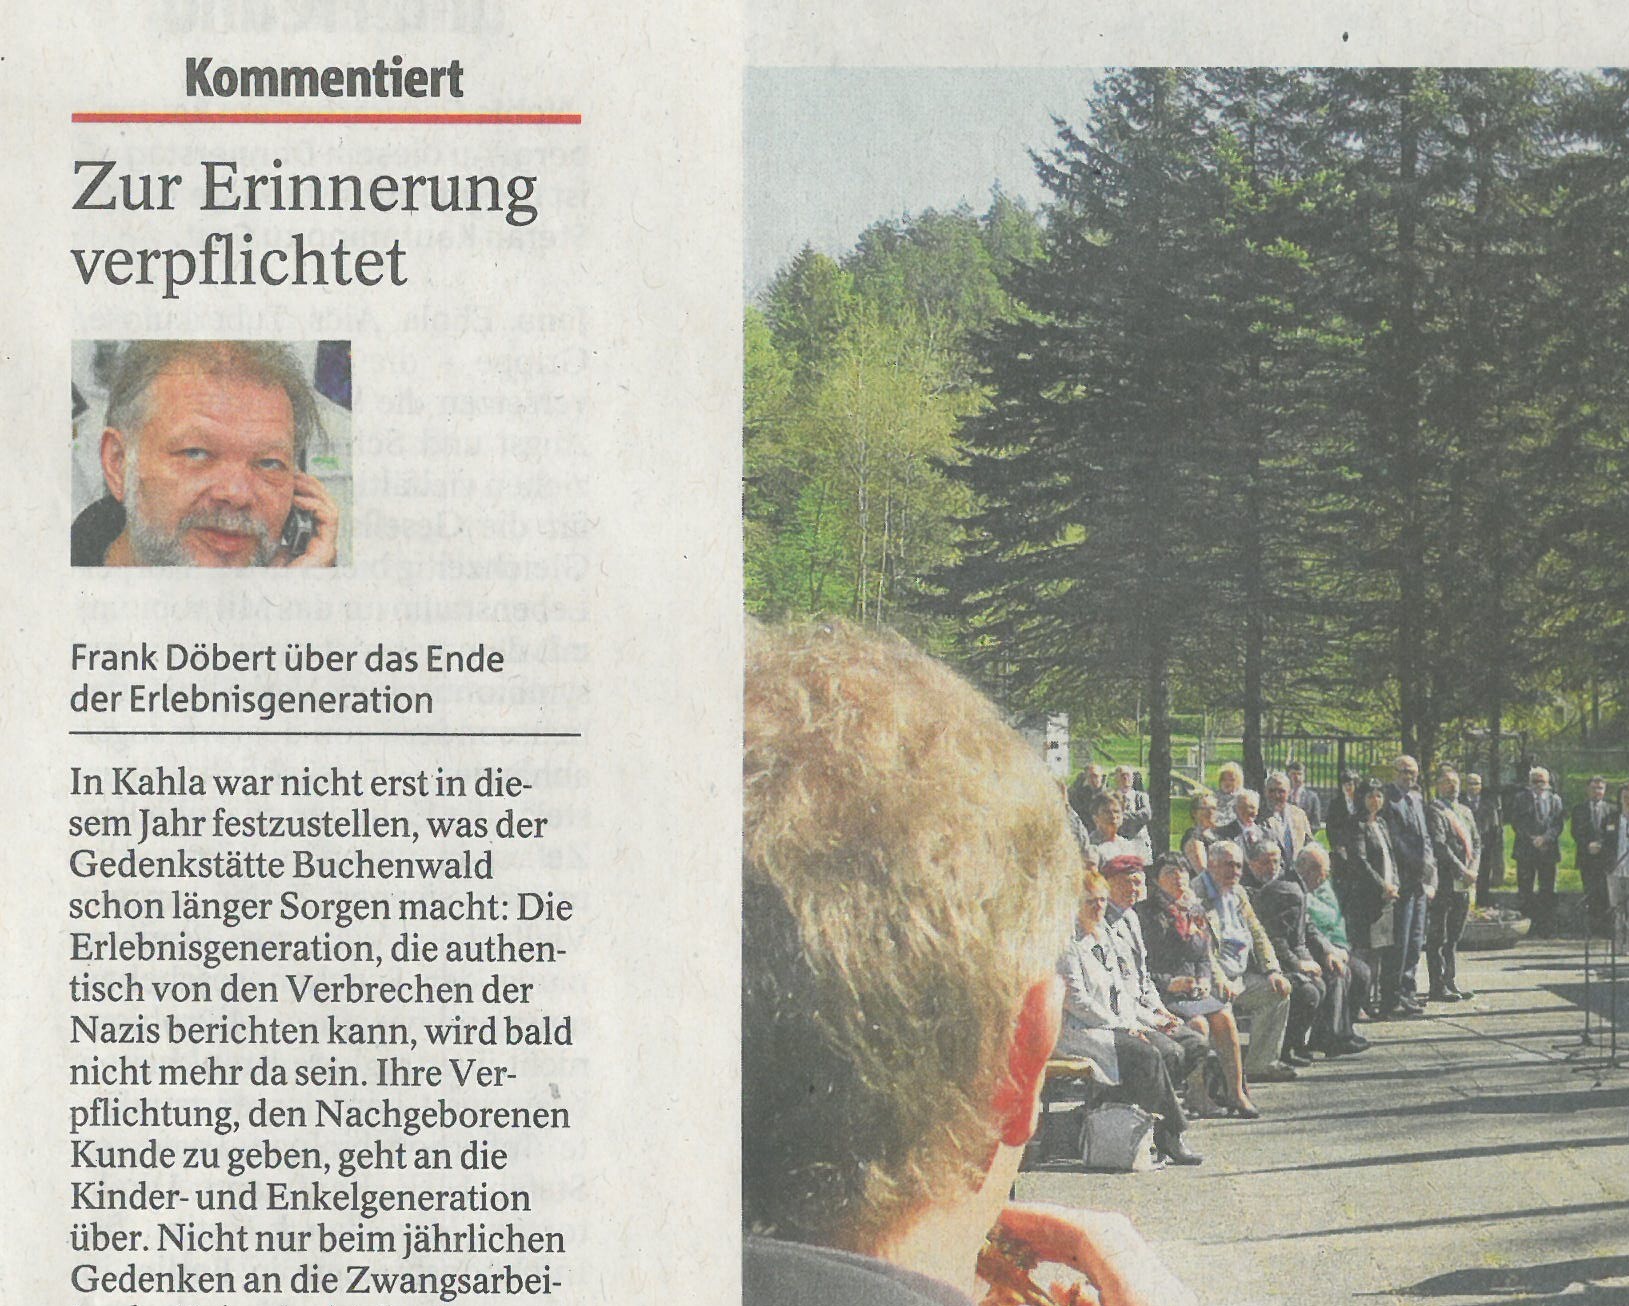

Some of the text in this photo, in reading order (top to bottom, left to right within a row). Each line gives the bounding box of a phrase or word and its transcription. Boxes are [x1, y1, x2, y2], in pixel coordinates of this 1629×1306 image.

[185, 54, 464, 99] Kommentiert
[71, 158, 538, 227] Zur Erinnerung
[69, 232, 408, 300] verpflichtet
[71, 641, 505, 673] Frank Döbert über das Ende
[70, 682, 433, 721] der Erlebnisgeneration
[70, 765, 533, 798] In Kahla war nicht erst in die-
[69, 1221, 566, 1260] über. Nicht nur beim jährlichen
